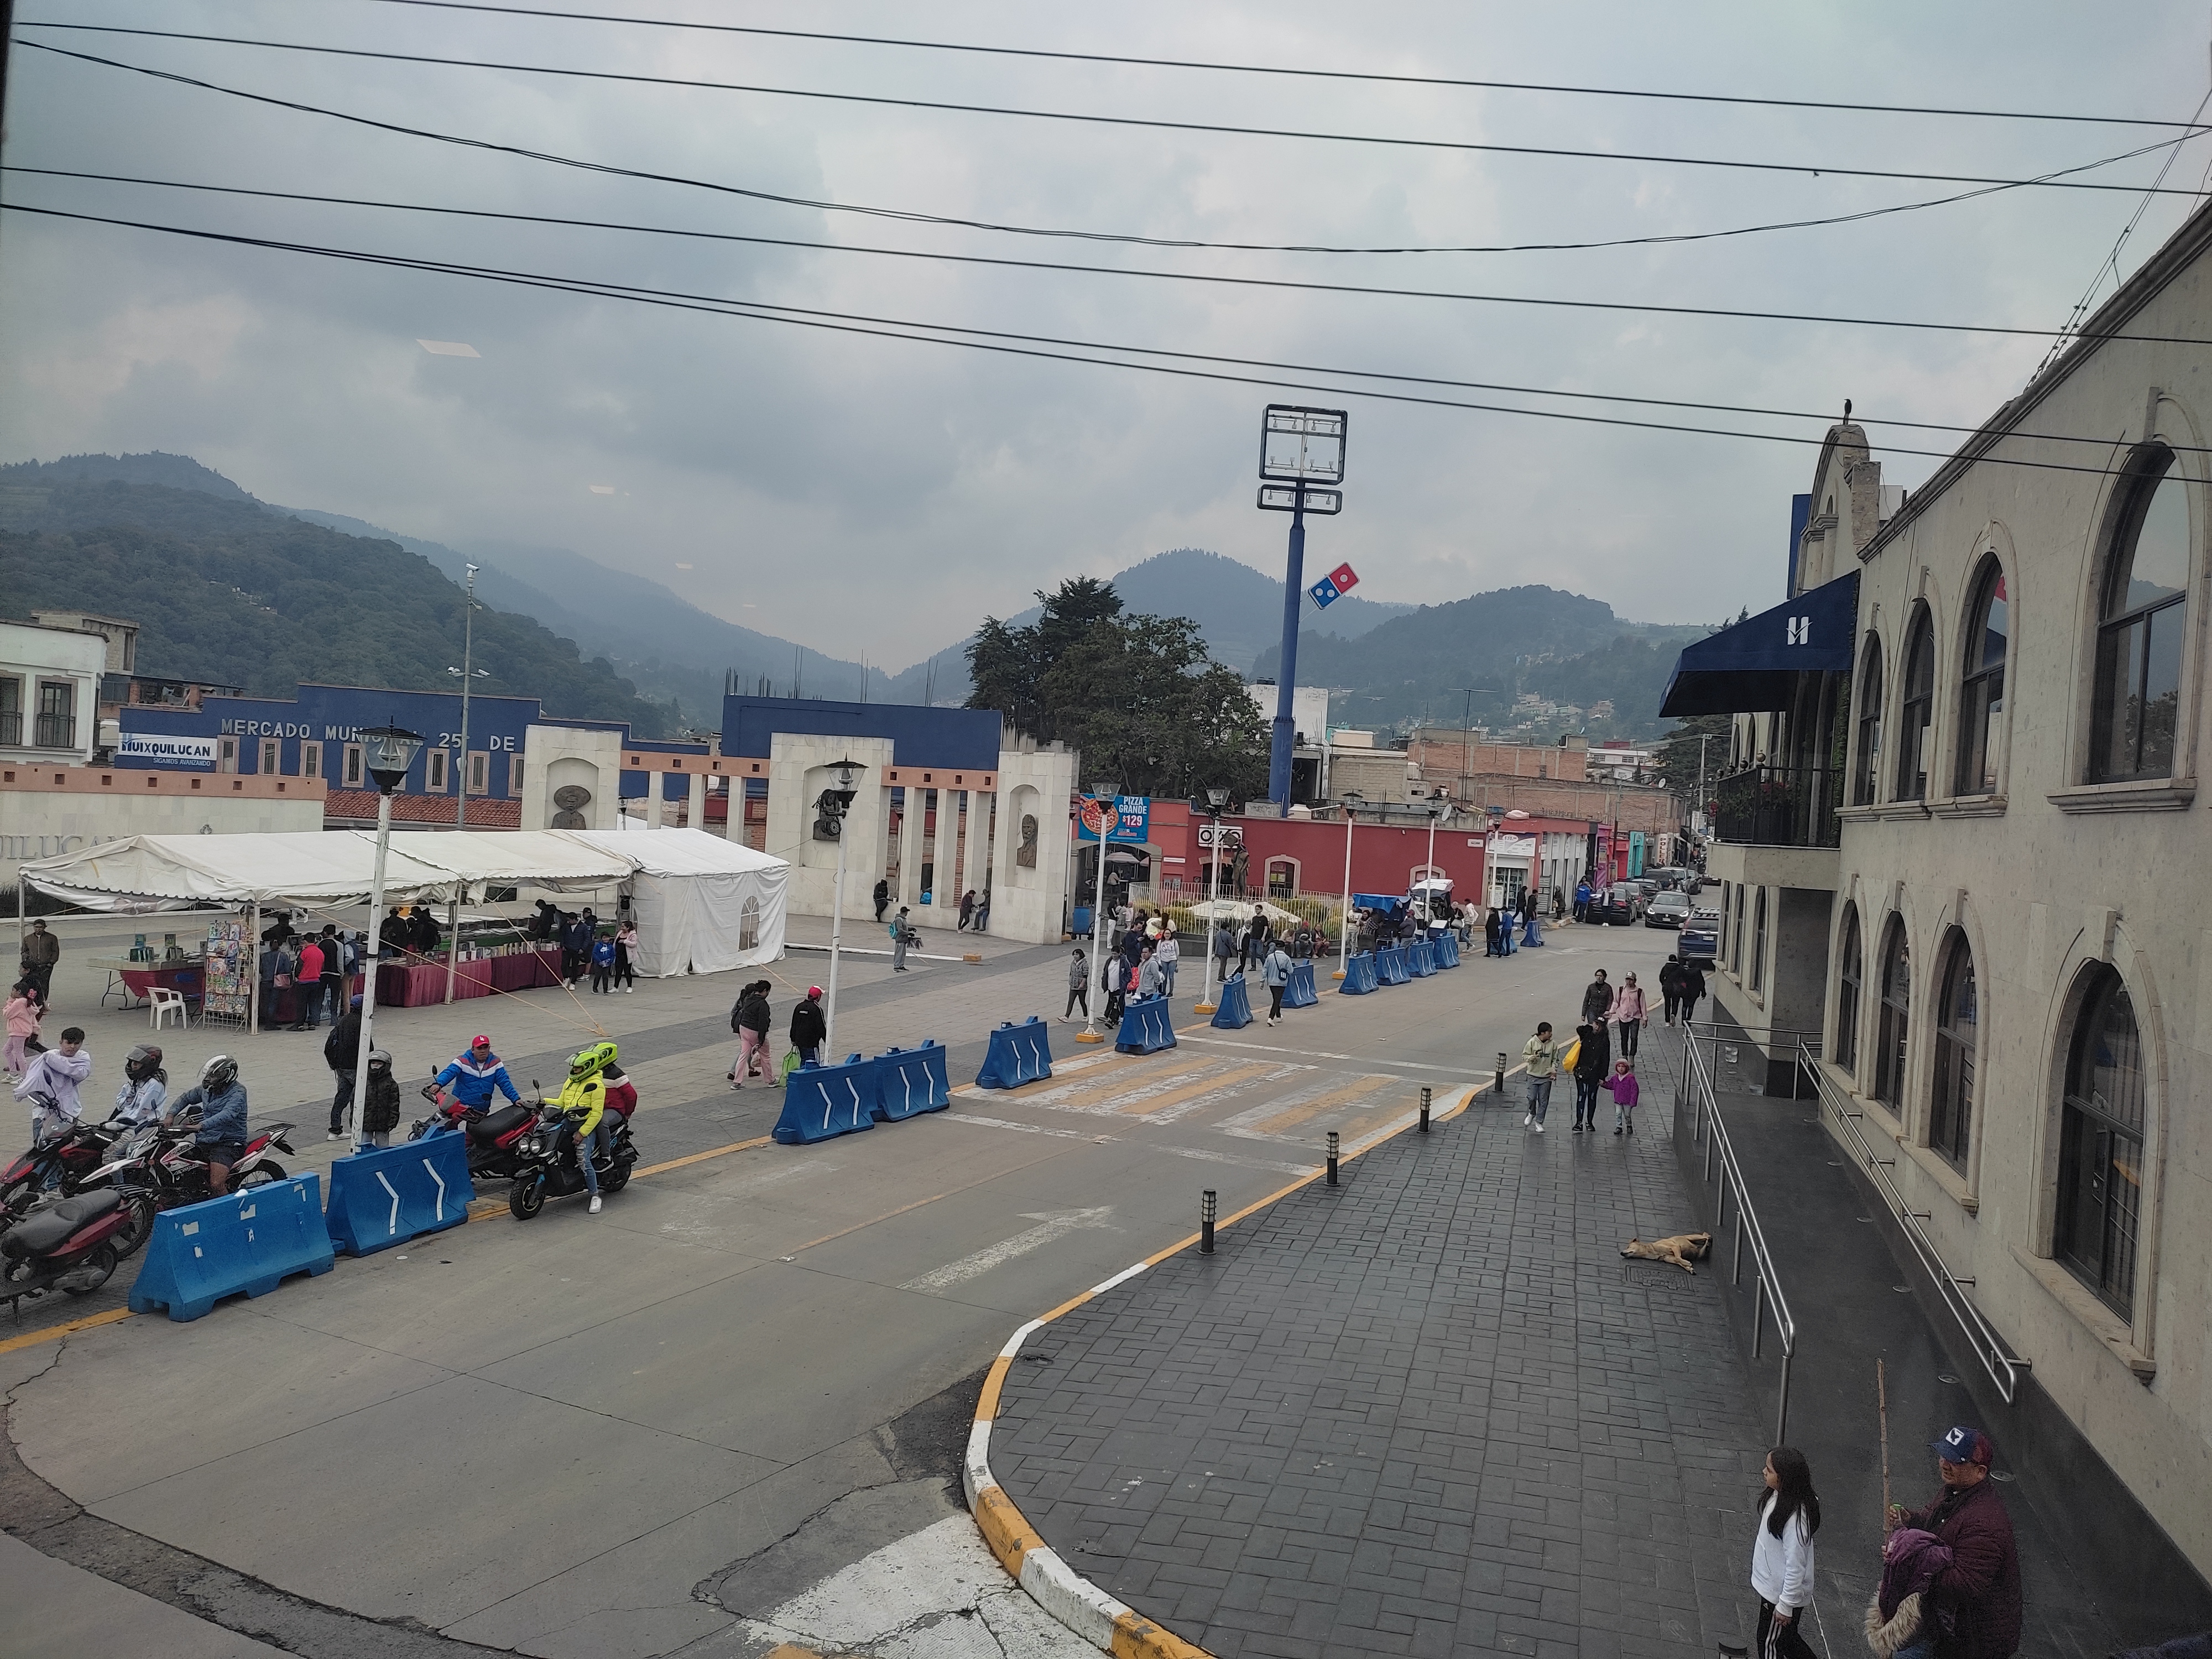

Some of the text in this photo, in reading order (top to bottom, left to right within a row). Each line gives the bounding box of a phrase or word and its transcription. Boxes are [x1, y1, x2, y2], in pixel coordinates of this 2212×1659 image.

[221, 718, 515, 752] MERCADO MUNIL 25 DE
[121, 734, 211, 757] HUIXQUILUCAN
[1124, 796, 1144, 806] PIZZA
[1119, 804, 1147, 815] GRANDE
[1122, 815, 1142, 827] $129
[1200, 830, 1241, 843] OO
[0, 834, 134, 860] ILUC
